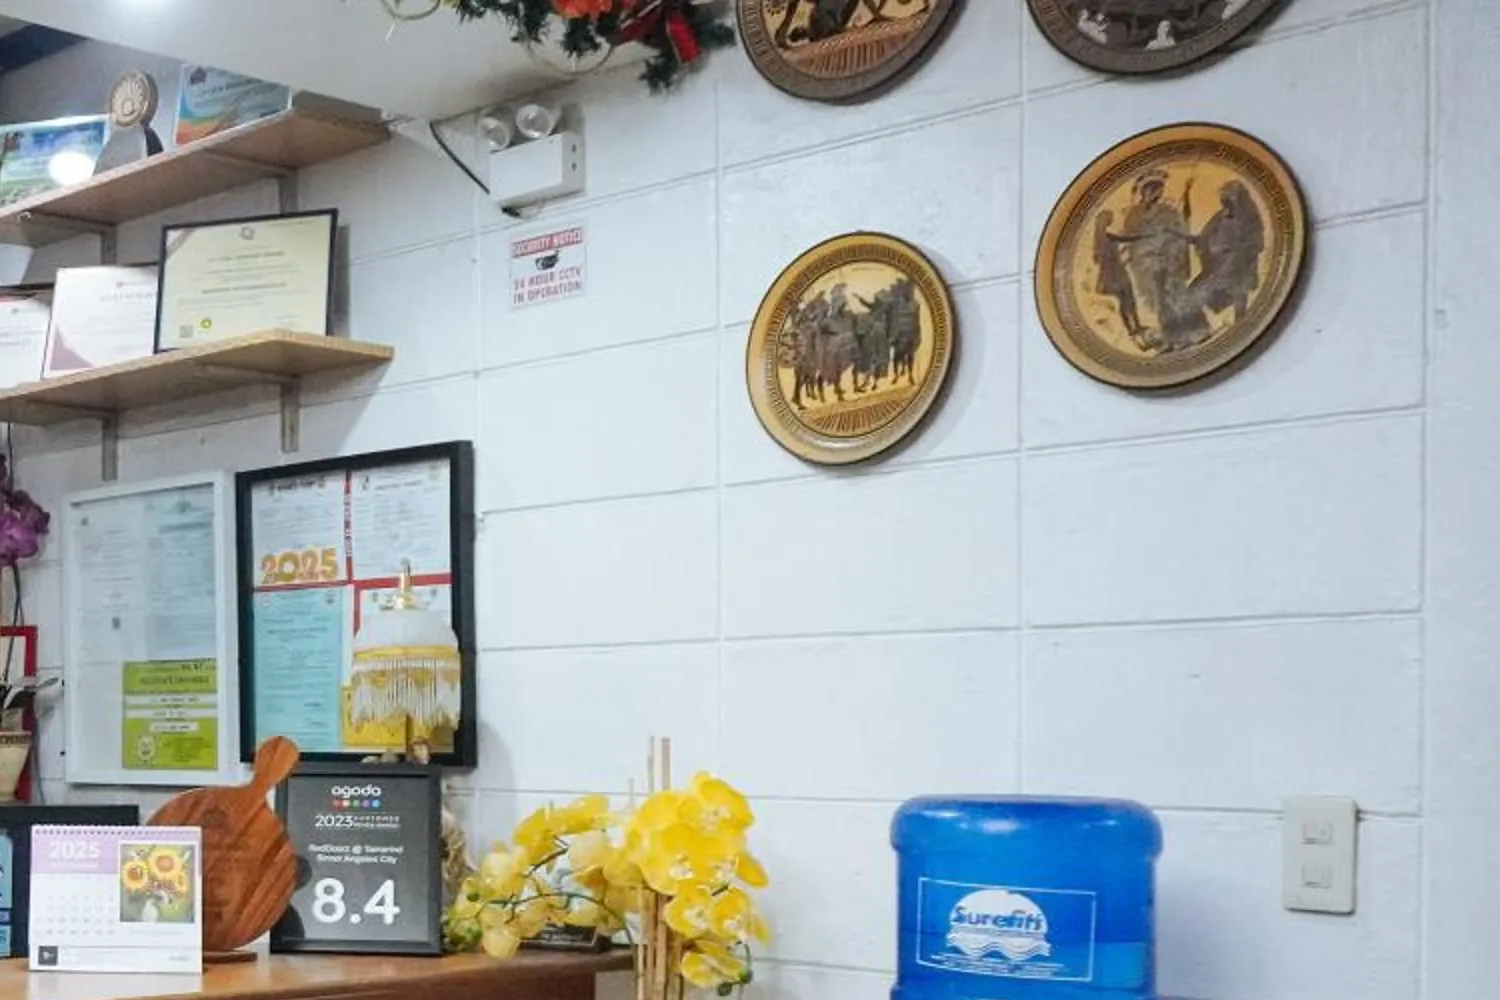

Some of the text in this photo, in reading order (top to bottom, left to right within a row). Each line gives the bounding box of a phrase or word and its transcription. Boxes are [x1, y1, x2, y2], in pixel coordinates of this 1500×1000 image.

[560, 266, 581, 280] CCTV
[260, 547, 339, 585] 2025
[331, 784, 382, 798] agoda
[50, 840, 101, 859] 2025
[379, 855, 399, 865] City
[312, 877, 400, 925] 8.4
